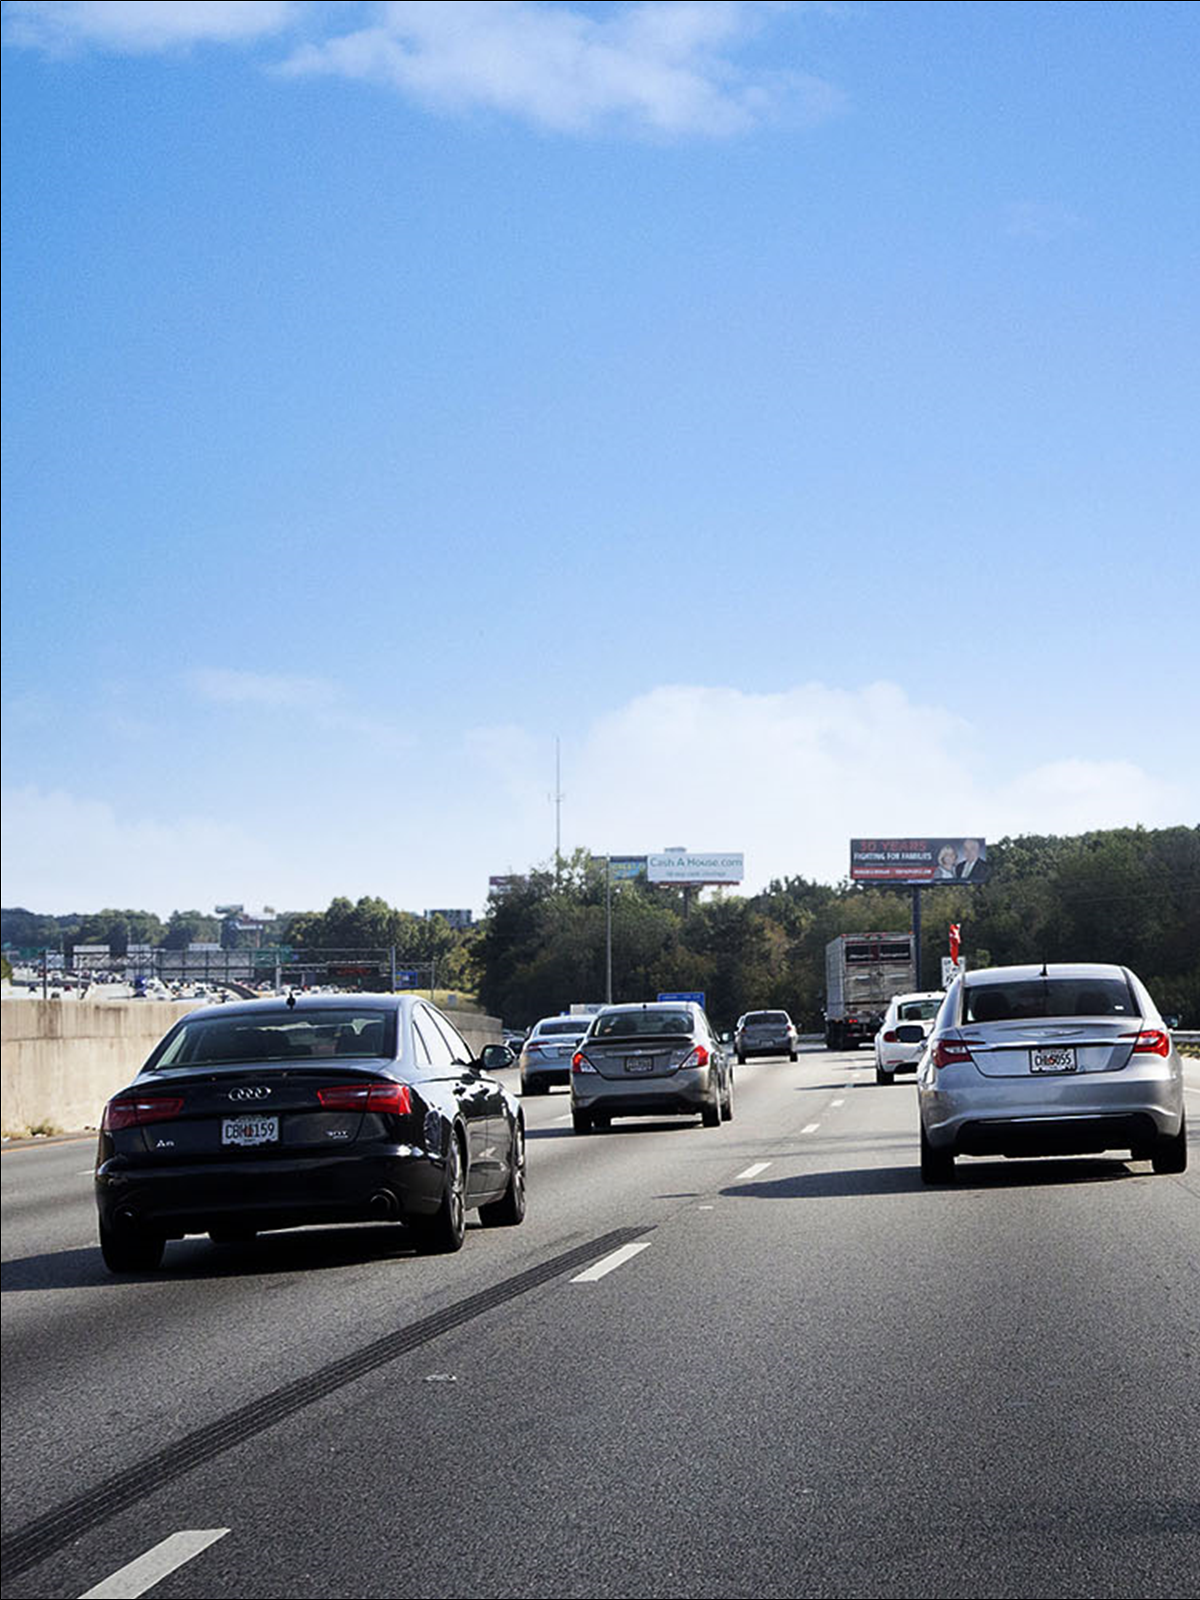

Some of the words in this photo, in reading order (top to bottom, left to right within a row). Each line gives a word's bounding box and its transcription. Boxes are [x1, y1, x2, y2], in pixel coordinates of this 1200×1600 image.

[882, 841, 926, 851] YEARS
[853, 852, 885, 861] FIGHTING
[886, 852, 900, 860] FOR
[901, 852, 933, 860] FAMILIES
[650, 857, 675, 867] Cash
[676, 858, 685, 867] A
[687, 857, 743, 867] House.com
